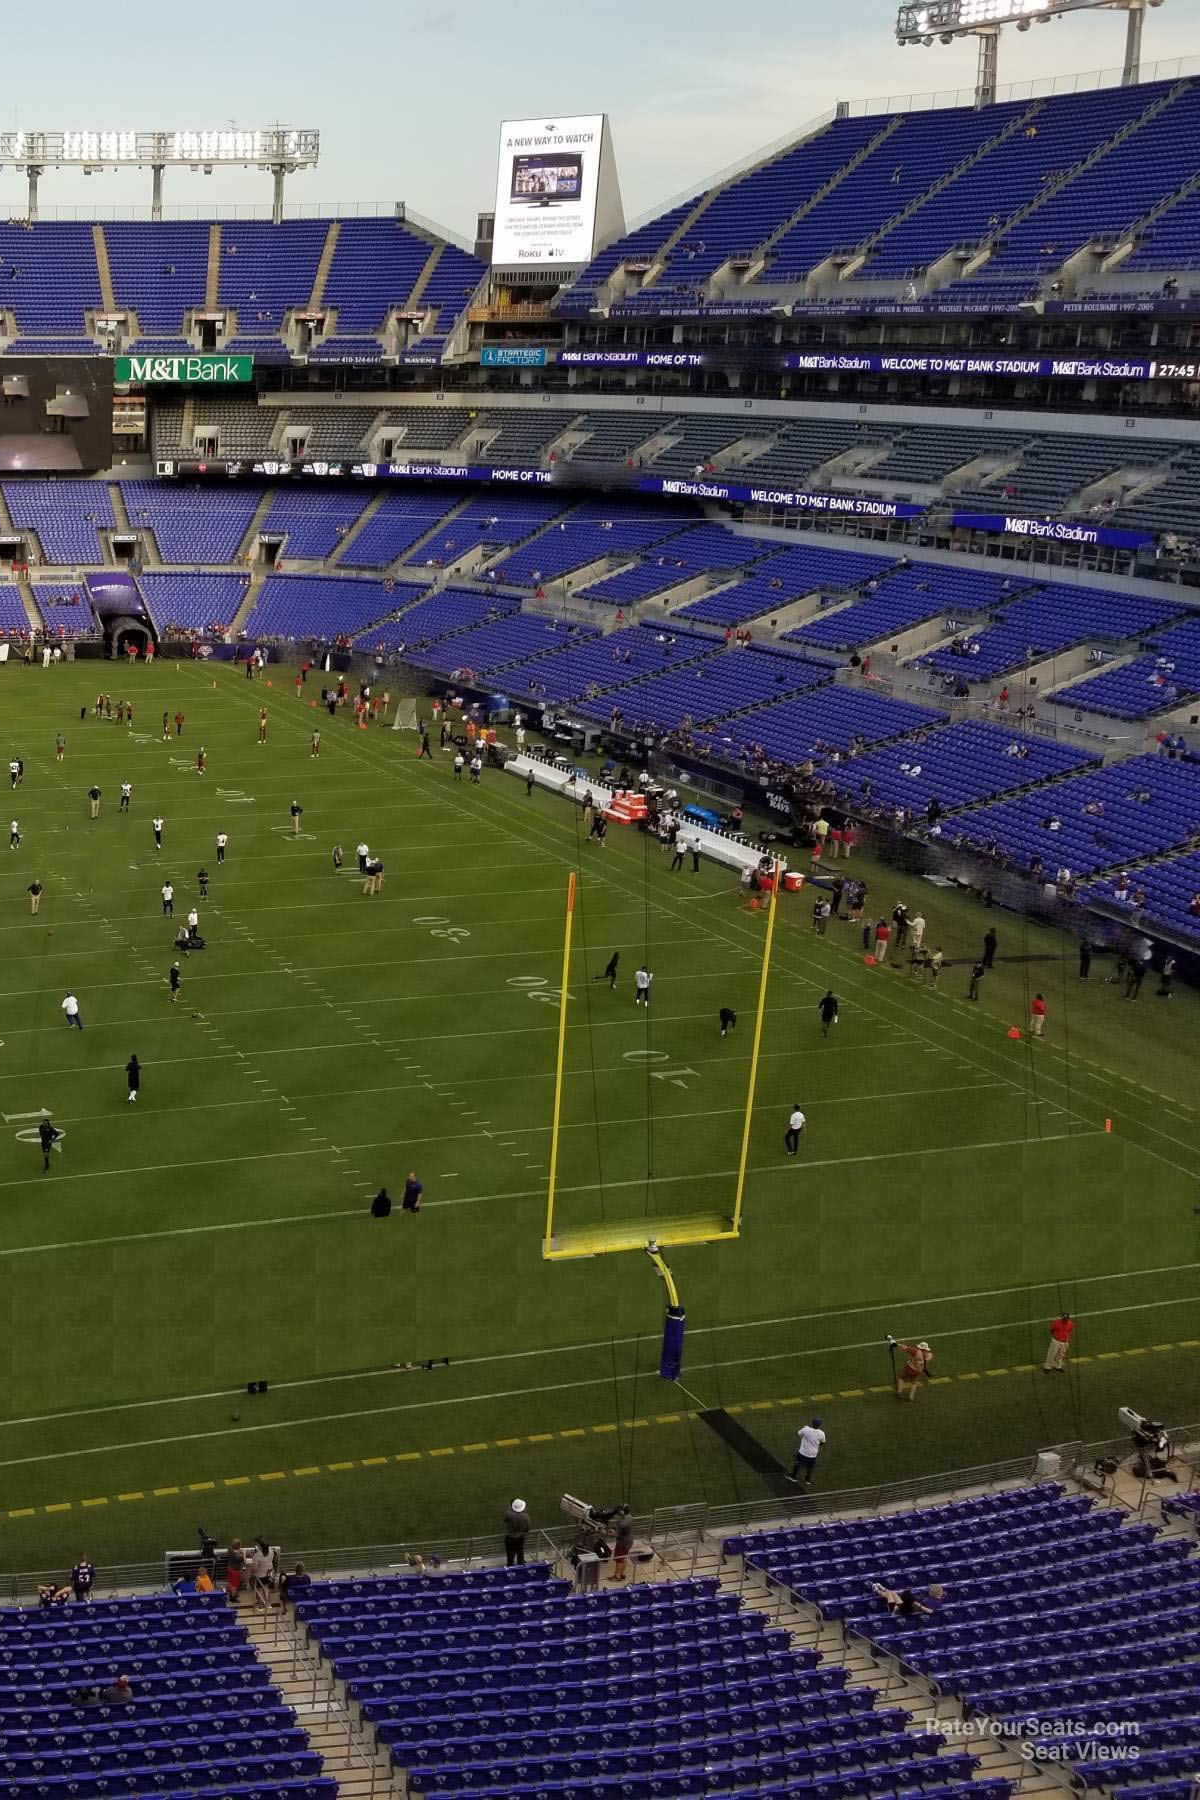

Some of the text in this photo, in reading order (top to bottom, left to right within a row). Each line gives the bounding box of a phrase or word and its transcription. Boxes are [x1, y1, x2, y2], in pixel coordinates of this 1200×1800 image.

[507, 133, 593, 147] A NEW WAY TO WATCH
[497, 356, 541, 364] FACTORY
[647, 355, 702, 365] HOME OF TH
[799, 356, 871, 370] M&T Bank Stadium
[881, 358, 1040, 373] WELCOME TO M&T BANK STADIUM
[129, 358, 239, 381] M&T Bank
[1052, 361, 1143, 377] M&T Bank Stadium
[1159, 365, 1195, 377] 27:45
[389, 465, 409, 474] M&T
[492, 470, 519, 480] HOME
[520, 470, 533, 481] OF
[663, 480, 728, 498] M&T Bank Stadium
[751, 489, 896, 516] WELCOME TO M&T BANK STADIUM
[1005, 517, 1097, 542] M&T Bank Stadium
